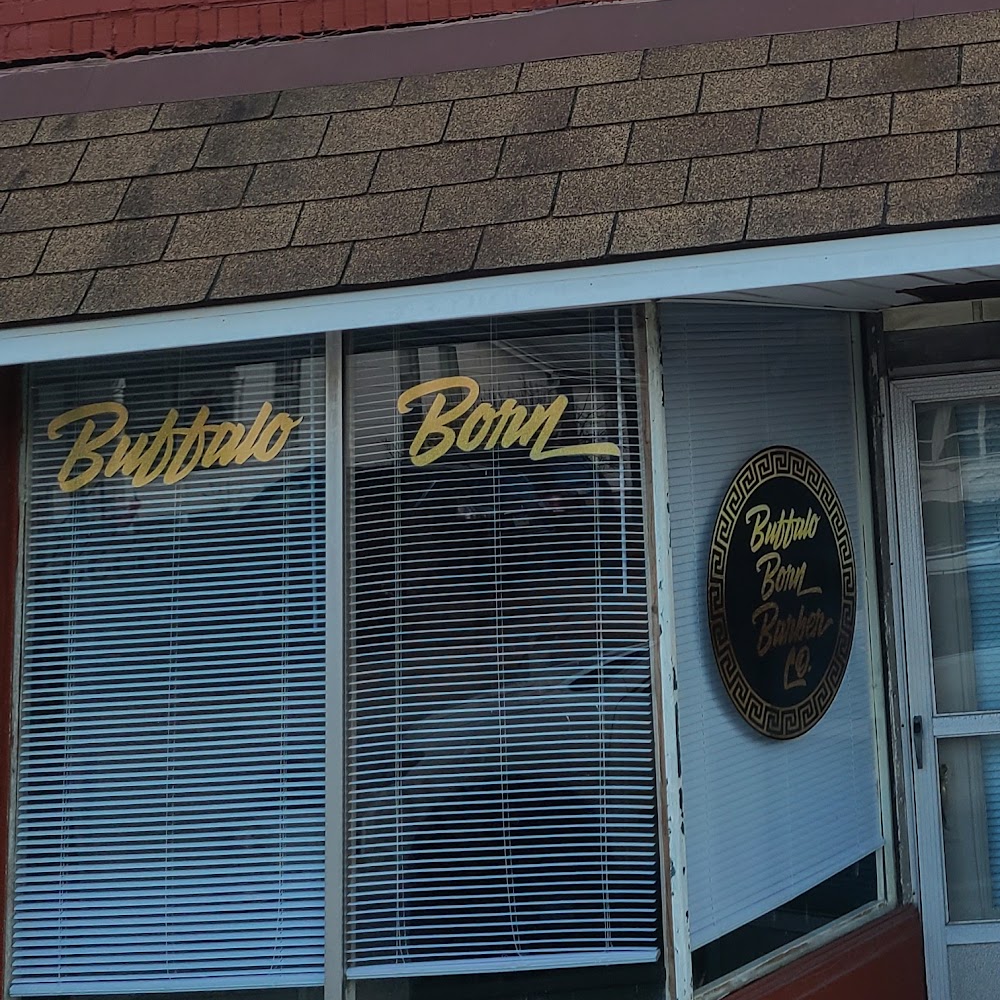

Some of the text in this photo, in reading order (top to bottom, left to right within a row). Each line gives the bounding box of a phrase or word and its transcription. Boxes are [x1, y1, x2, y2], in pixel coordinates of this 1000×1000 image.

[47, 401, 304, 493] Buffalo
[397, 376, 621, 467] Born
[745, 503, 820, 553] Buffalo
[755, 551, 822, 601] Born
[751, 601, 834, 657] Barber
